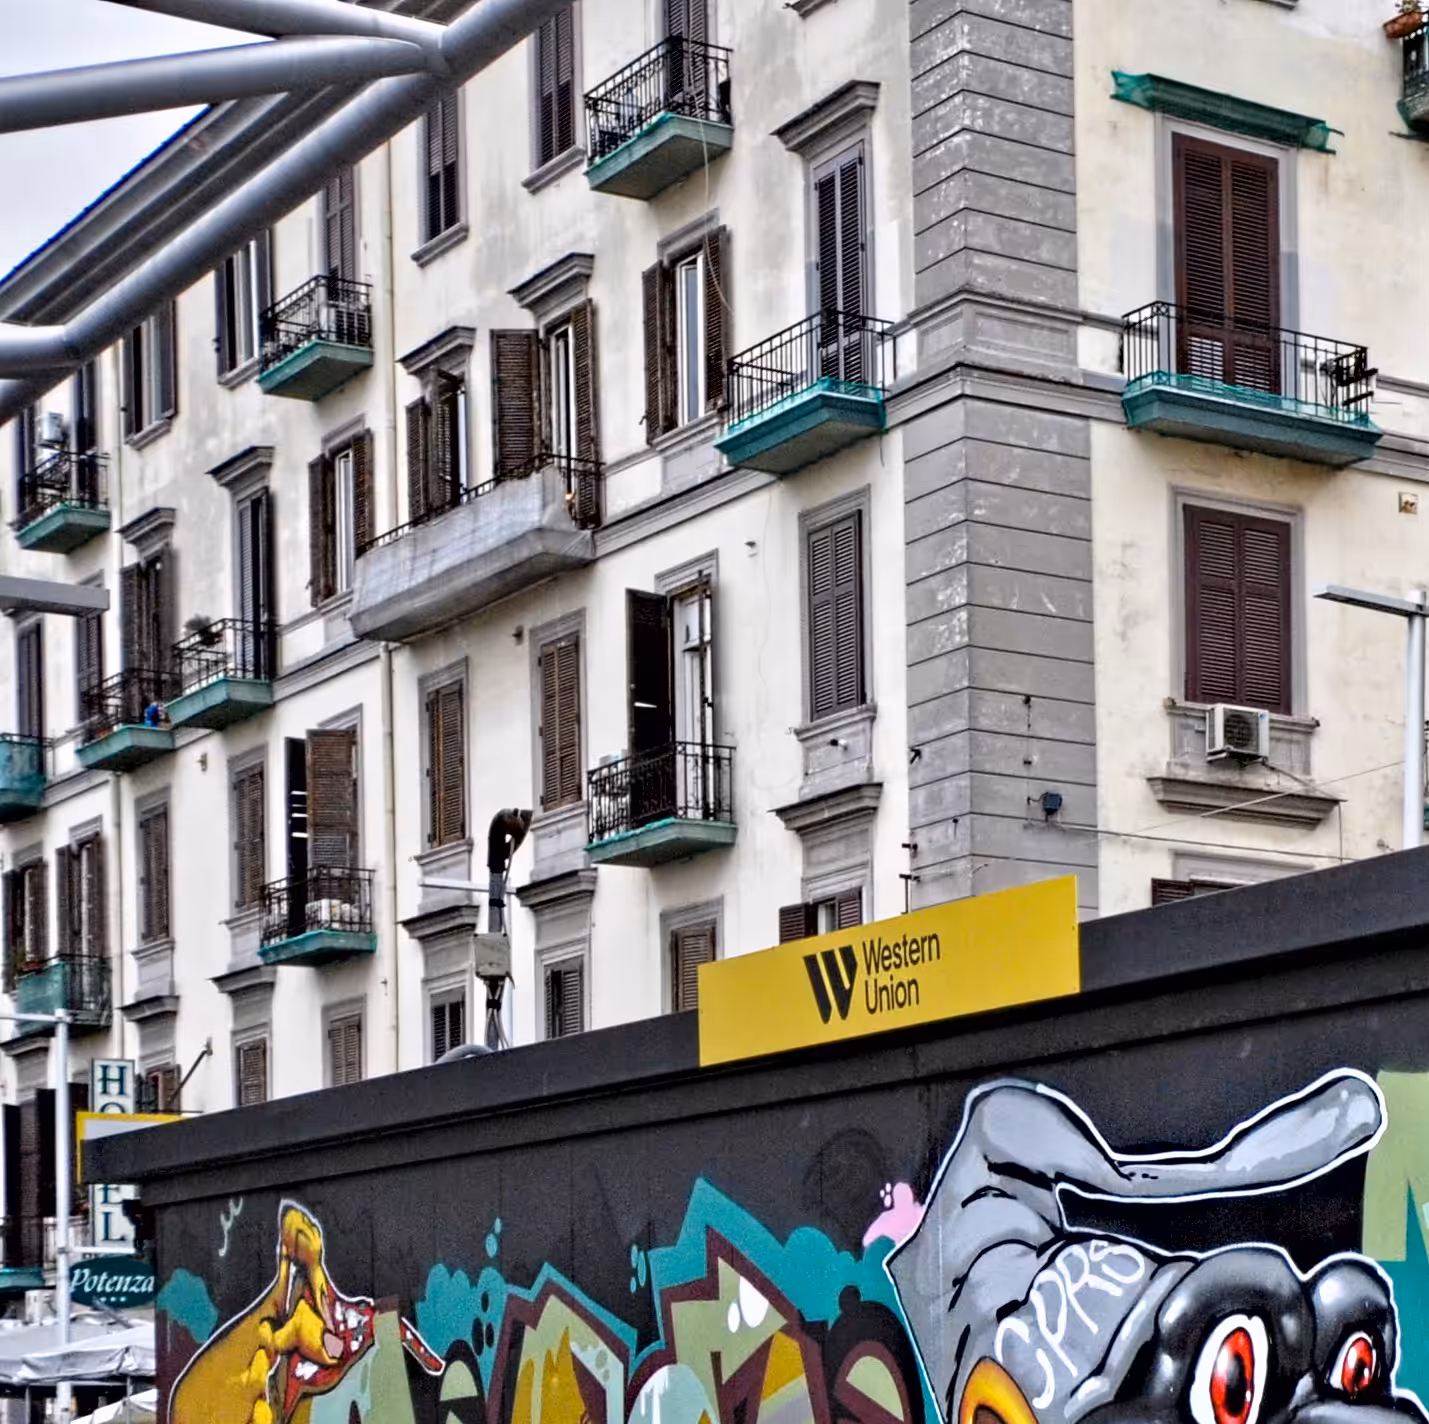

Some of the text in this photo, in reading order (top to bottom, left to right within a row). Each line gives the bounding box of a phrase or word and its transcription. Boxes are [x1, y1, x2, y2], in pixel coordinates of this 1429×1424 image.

[862, 932, 940, 974] Western
[865, 977, 920, 1014] Union
[70, 1267, 155, 1293] Potenza
